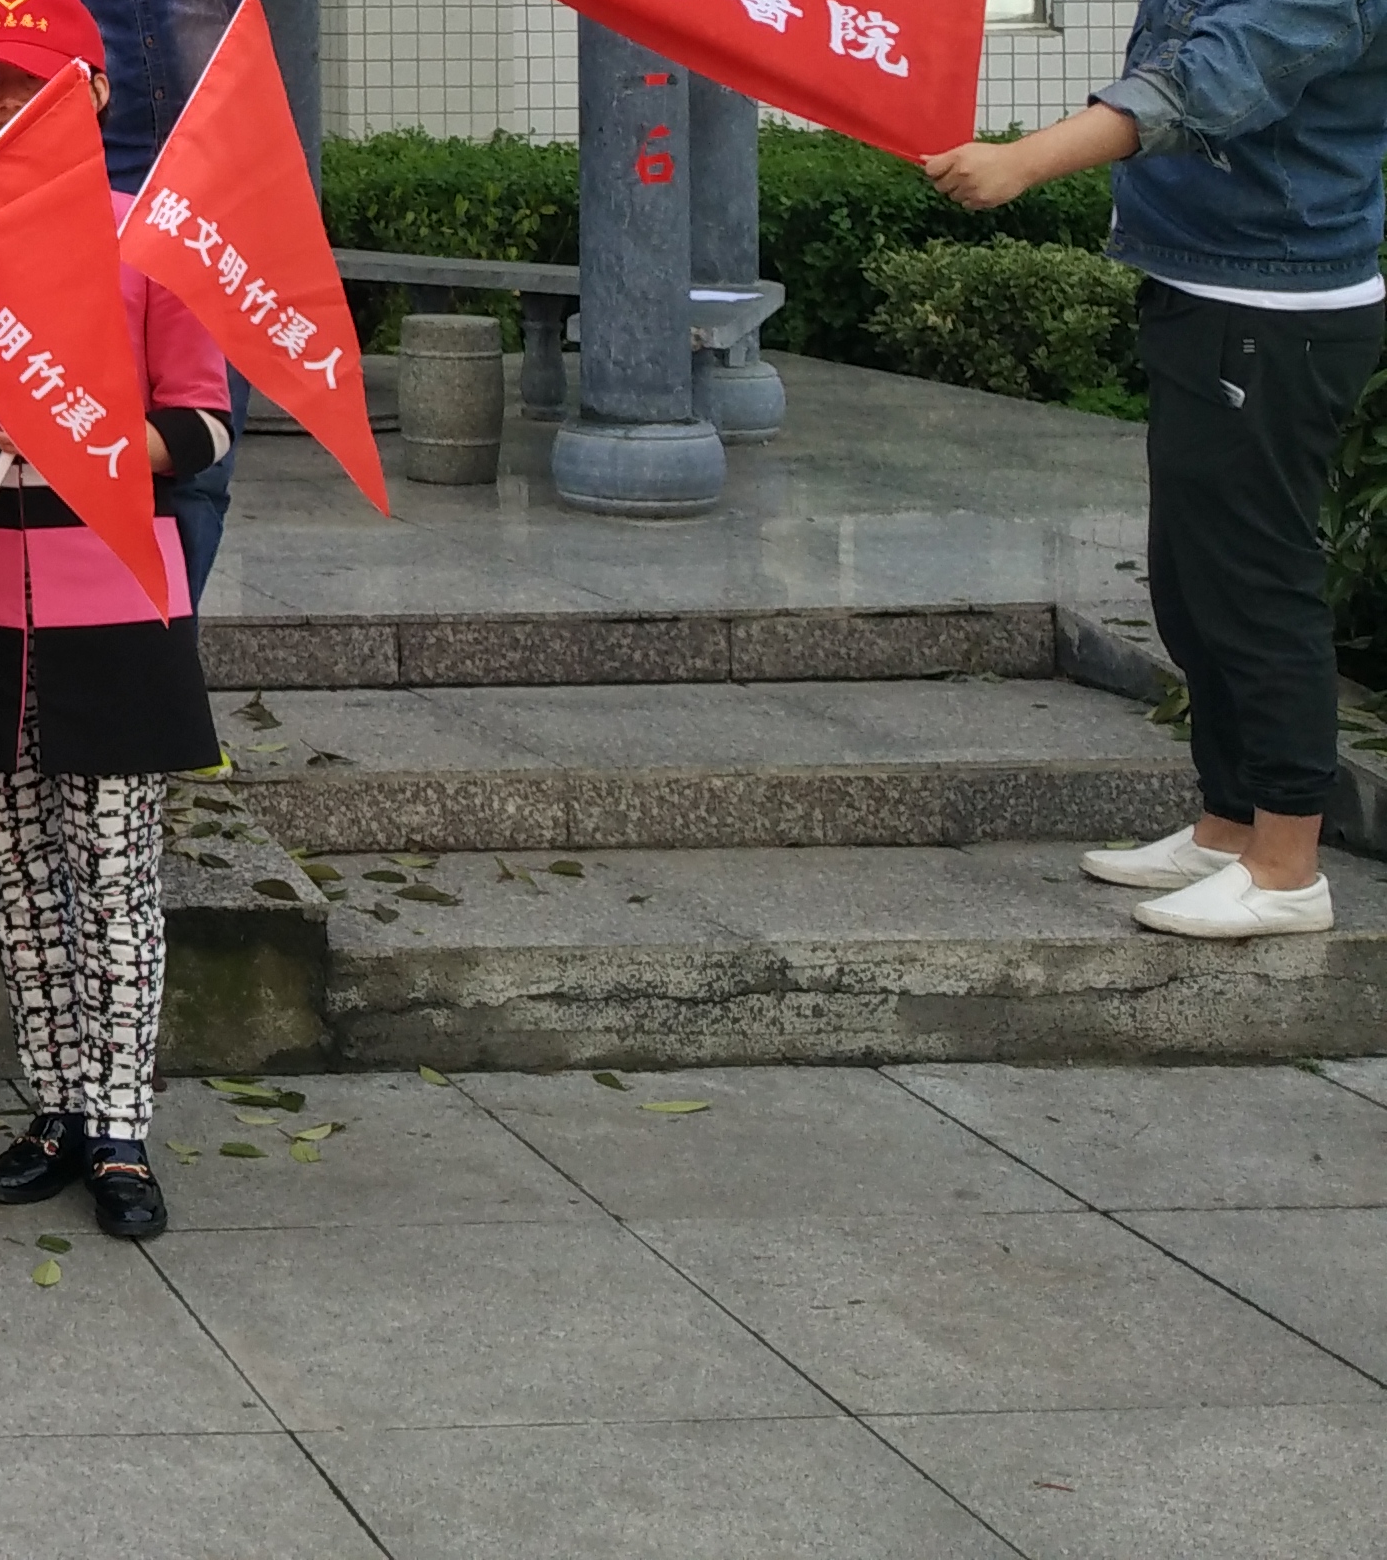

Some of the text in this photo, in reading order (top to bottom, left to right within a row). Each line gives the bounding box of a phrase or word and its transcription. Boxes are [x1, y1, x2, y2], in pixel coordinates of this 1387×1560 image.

[148, 187, 343, 390] 做文明竹溪人
